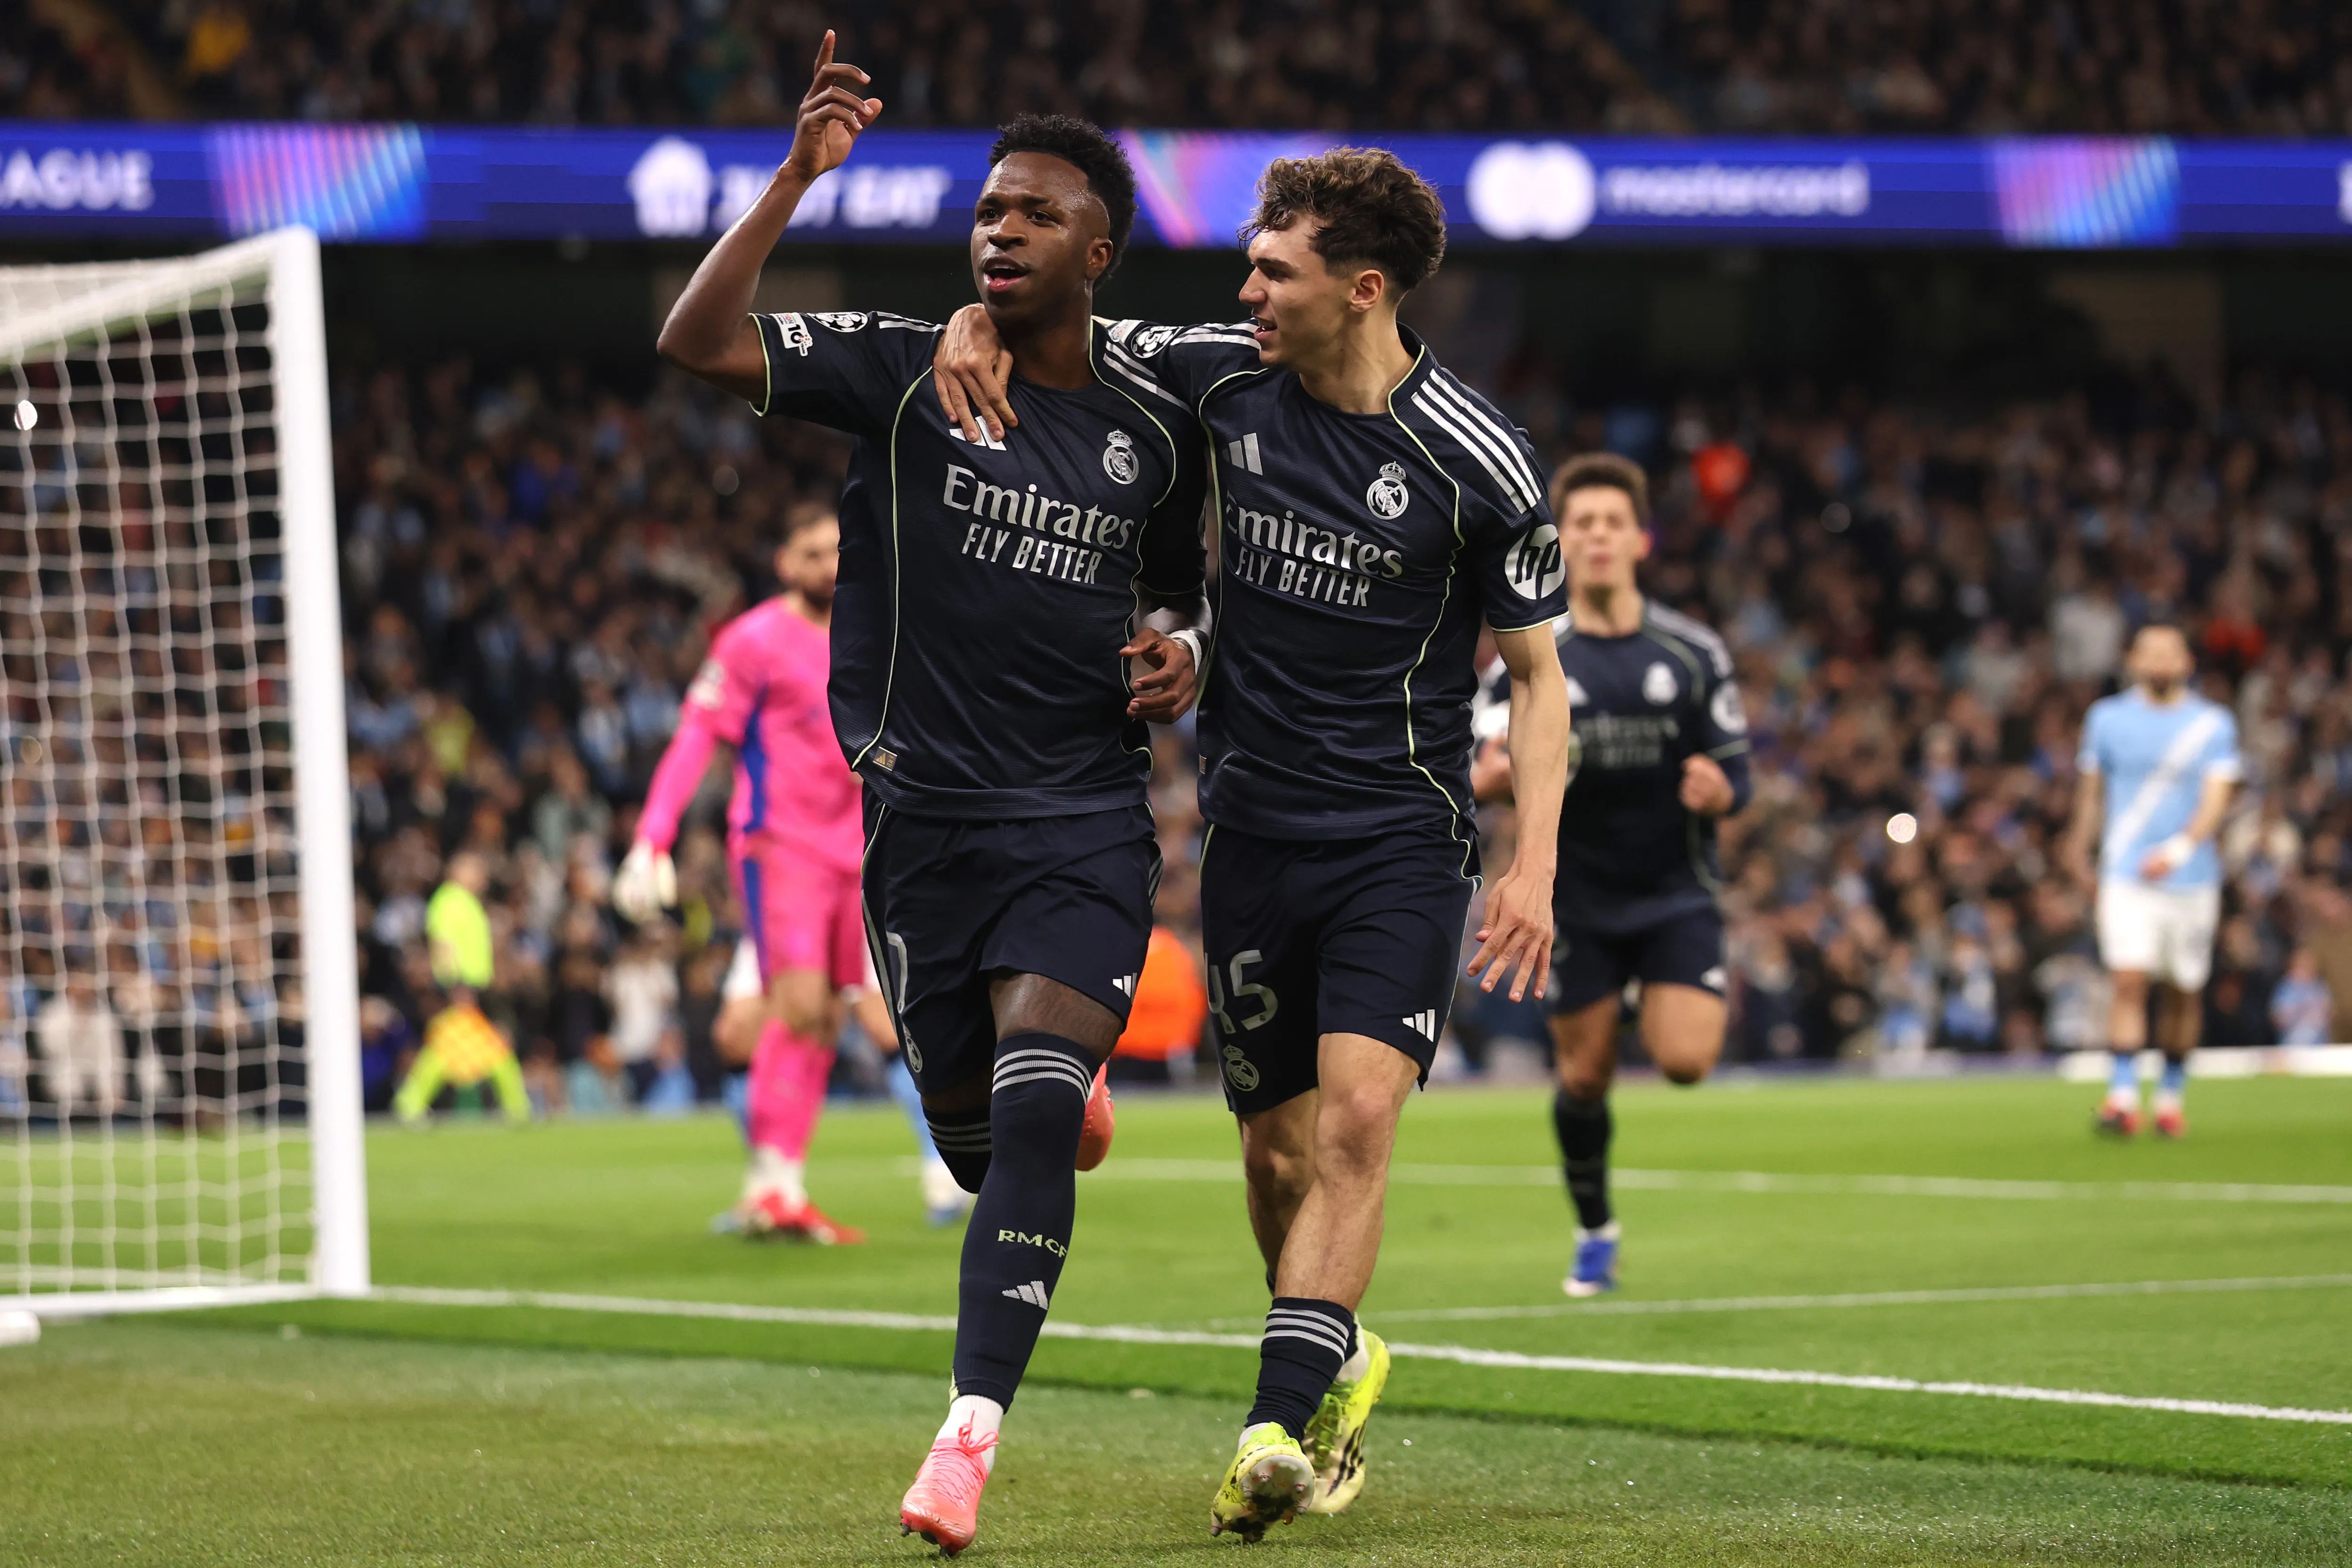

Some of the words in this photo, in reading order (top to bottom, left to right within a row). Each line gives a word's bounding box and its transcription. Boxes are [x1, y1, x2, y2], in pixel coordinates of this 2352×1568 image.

[0, 150, 153, 210] AGUE
[944, 463, 1134, 549] Emirates
[962, 523, 1010, 563] FLY
[1013, 536, 1102, 584] BETTER
[1235, 546, 1272, 586] FLY
[1278, 559, 1370, 606] BETTER
[1513, 525, 1562, 600] hp
